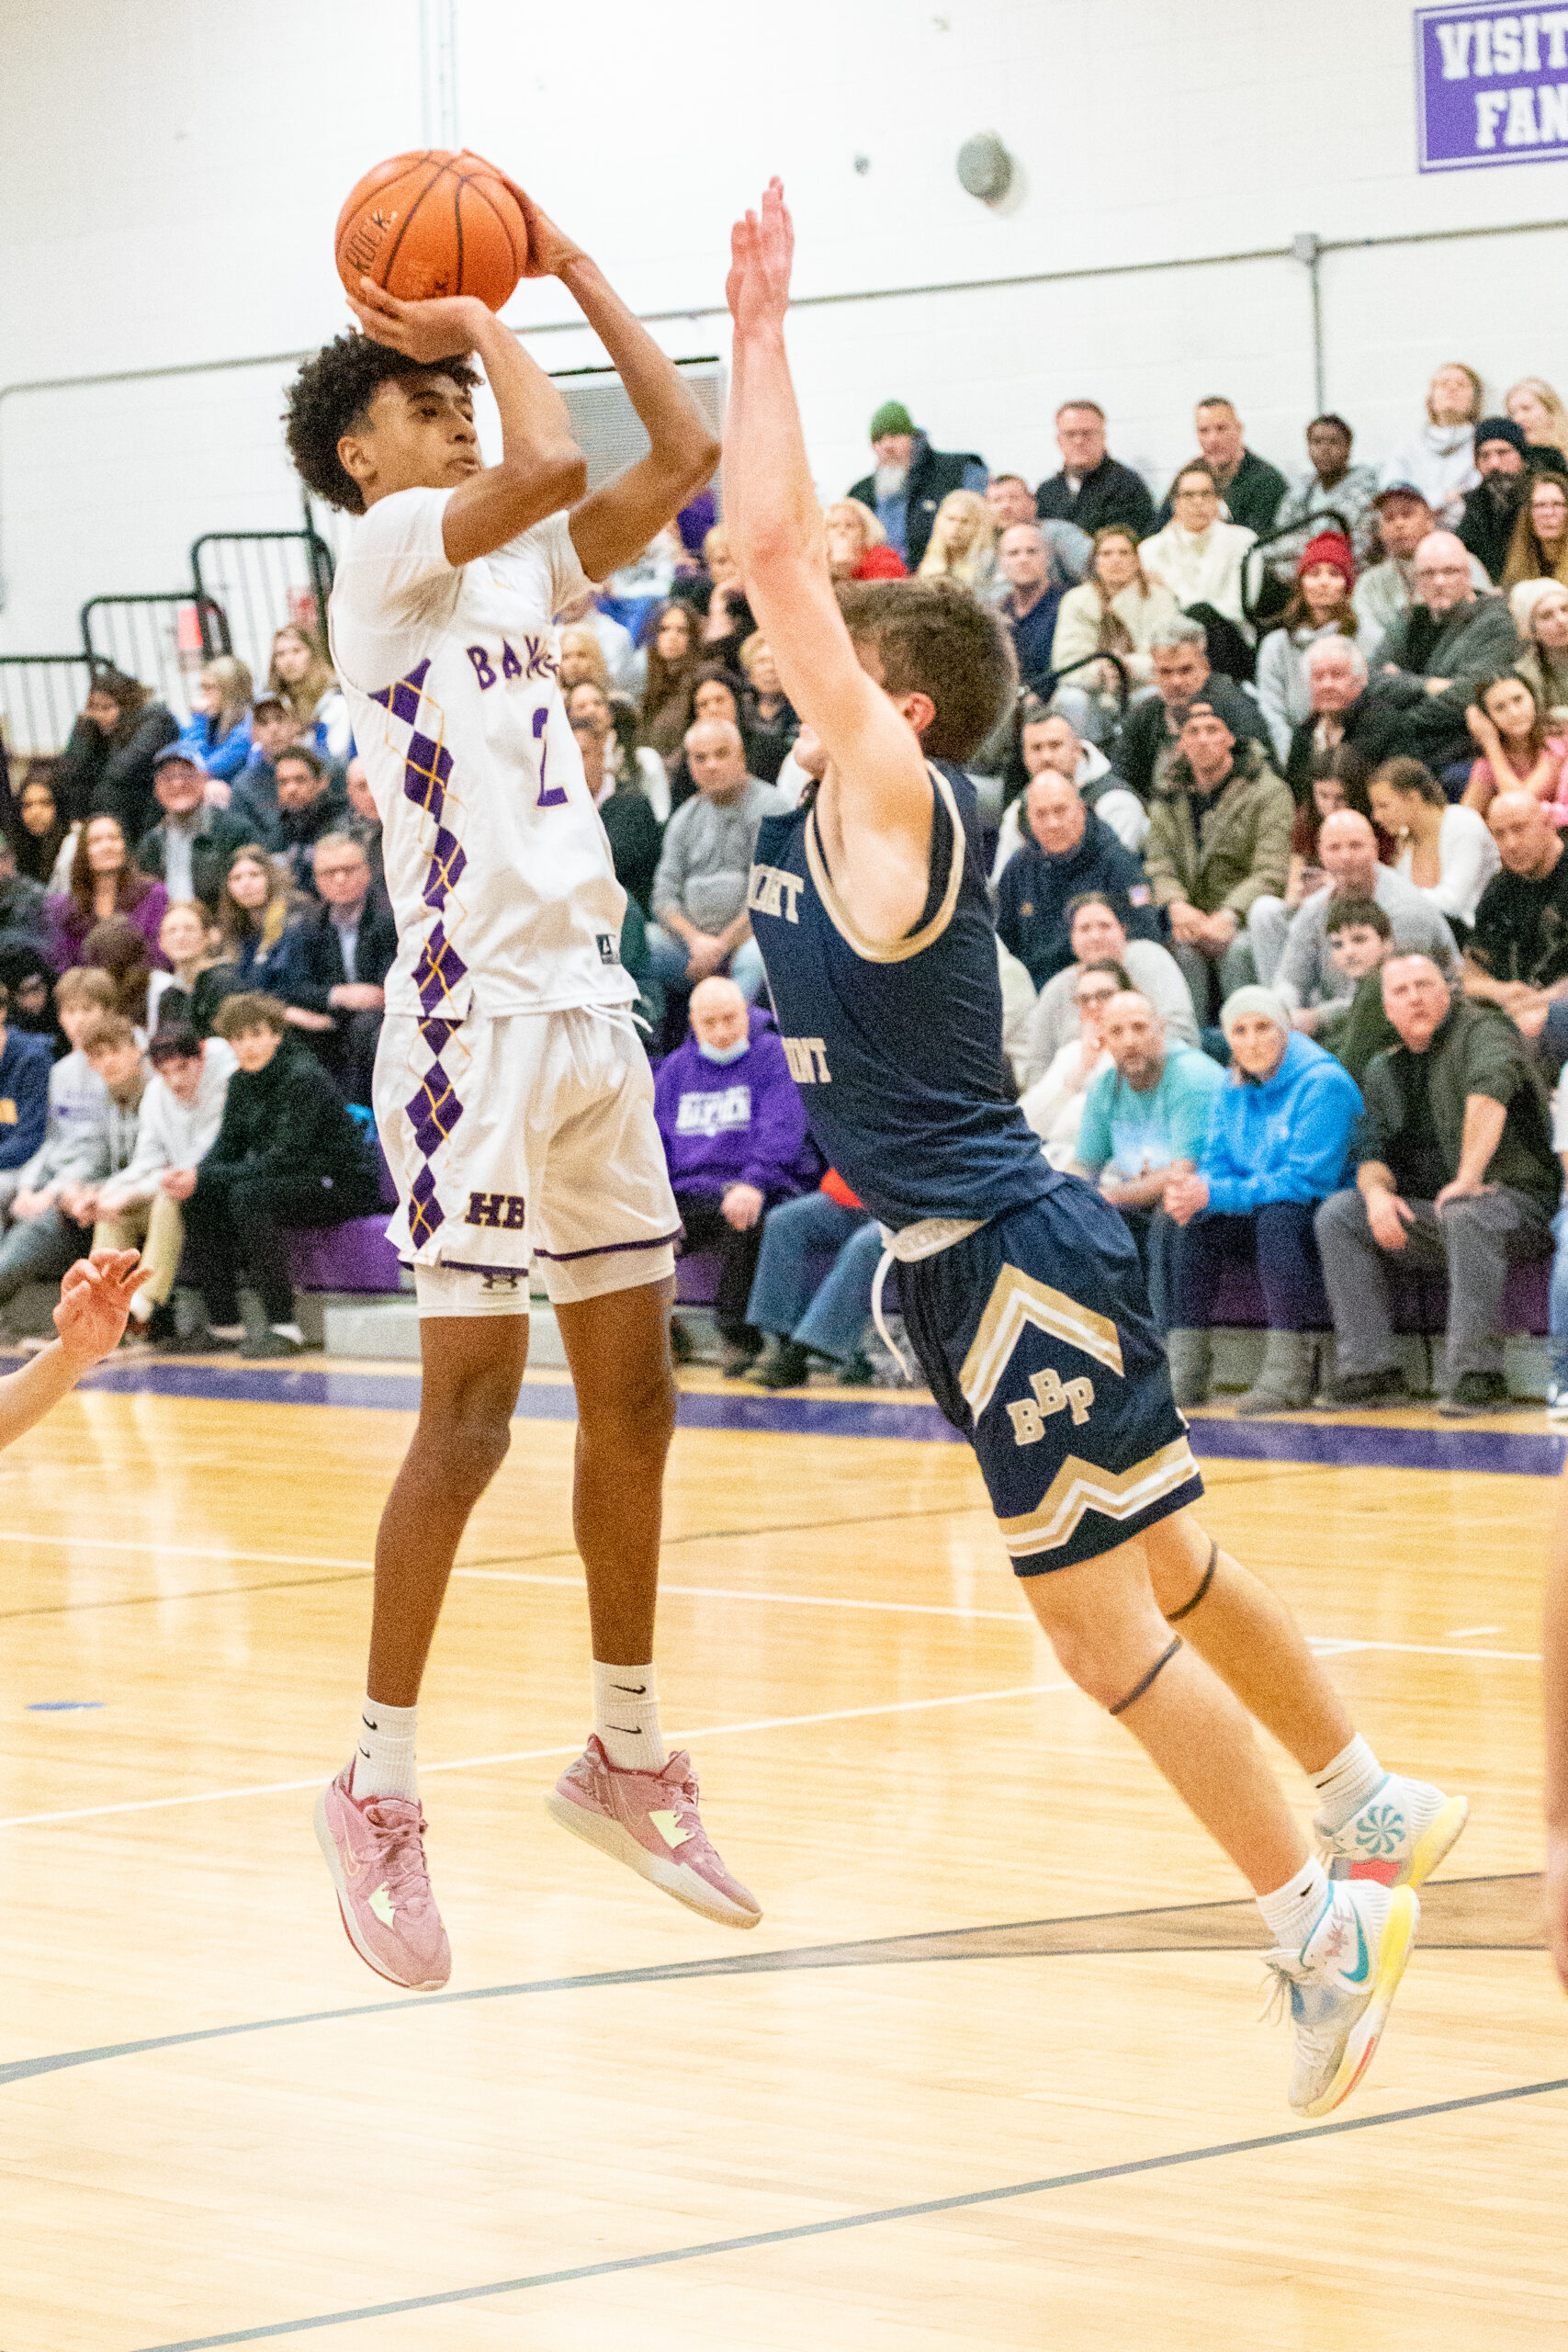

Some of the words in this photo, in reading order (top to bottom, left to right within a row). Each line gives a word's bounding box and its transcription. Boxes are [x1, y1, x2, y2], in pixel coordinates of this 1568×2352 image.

[1436, 11, 1568, 81] VISIT
[1475, 83, 1568, 150] FAN
[532, 707, 569, 807] 2
[465, 1192, 525, 1229] HB
[1006, 1367, 1095, 1446] BBP
